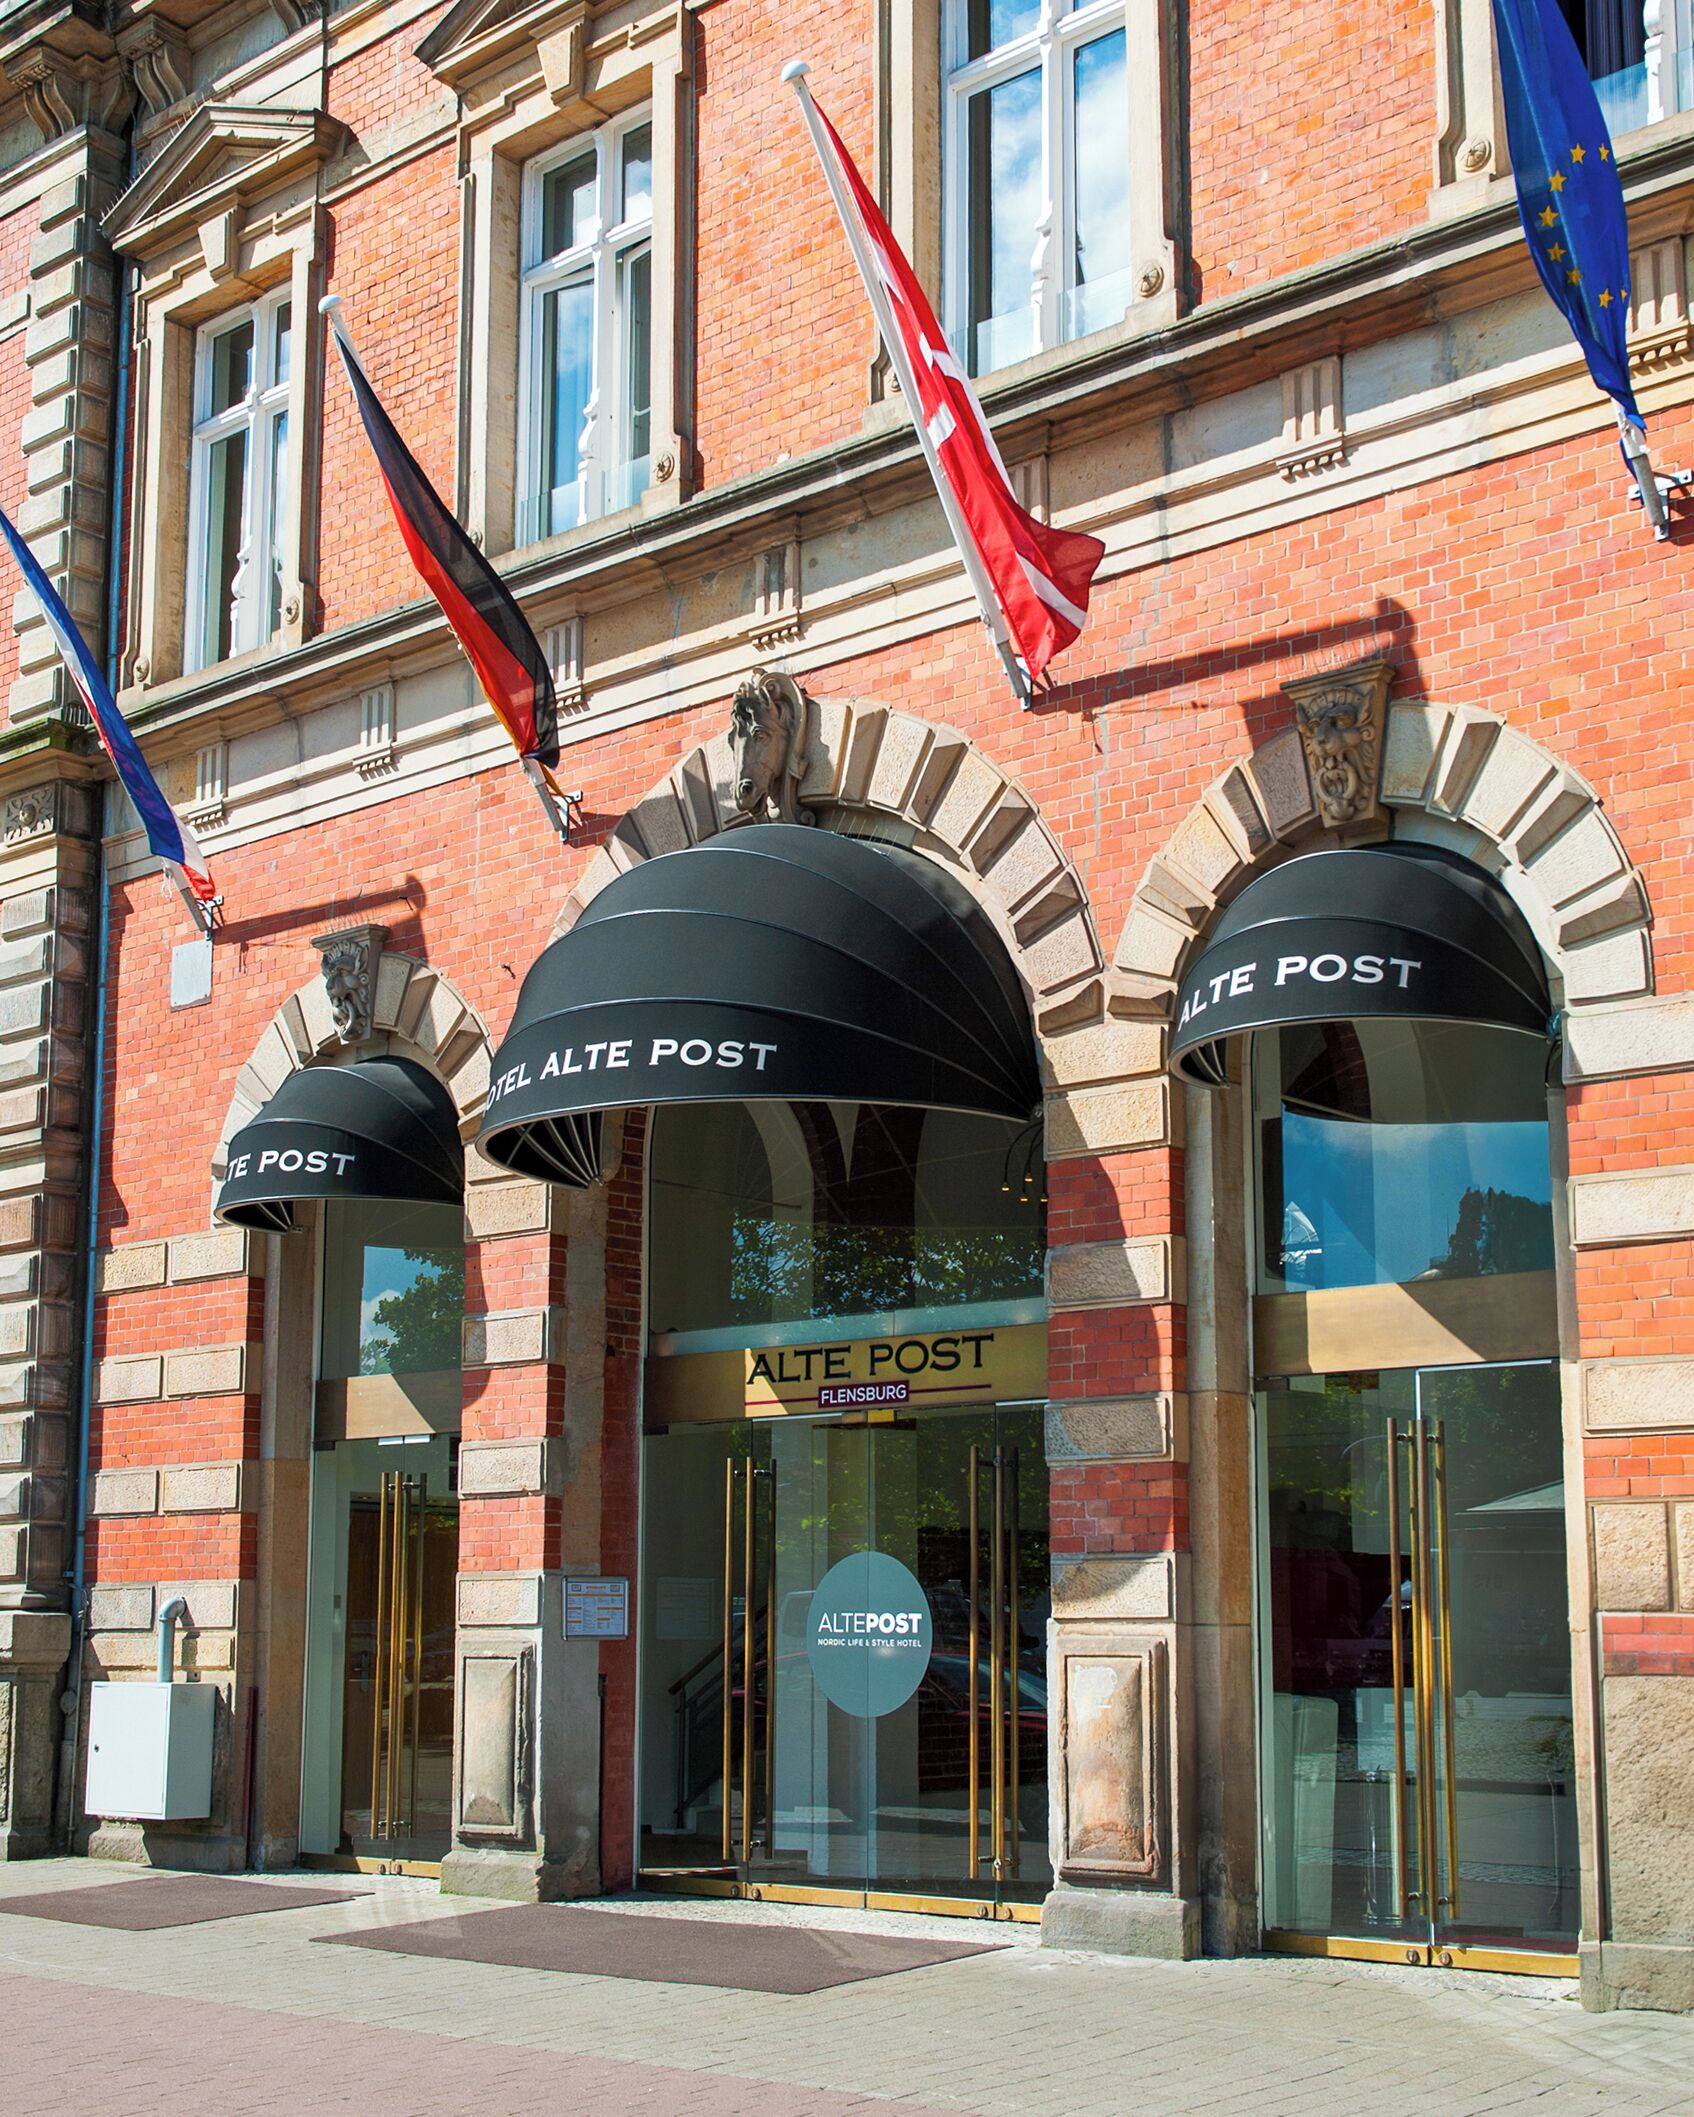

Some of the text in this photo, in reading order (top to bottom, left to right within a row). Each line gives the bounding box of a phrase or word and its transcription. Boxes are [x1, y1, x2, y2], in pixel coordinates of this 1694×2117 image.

[1177, 953, 1422, 1033] ALTE POST
[483, 1038, 778, 1116] OTEL ALTE POST
[257, 1149, 356, 1176] POST
[746, 1332, 995, 1385] ALTE POST
[820, 1384, 908, 1406] FLENSBURG
[817, 1638, 922, 1648] NORDIC LIFE & STYLE HOTEL
